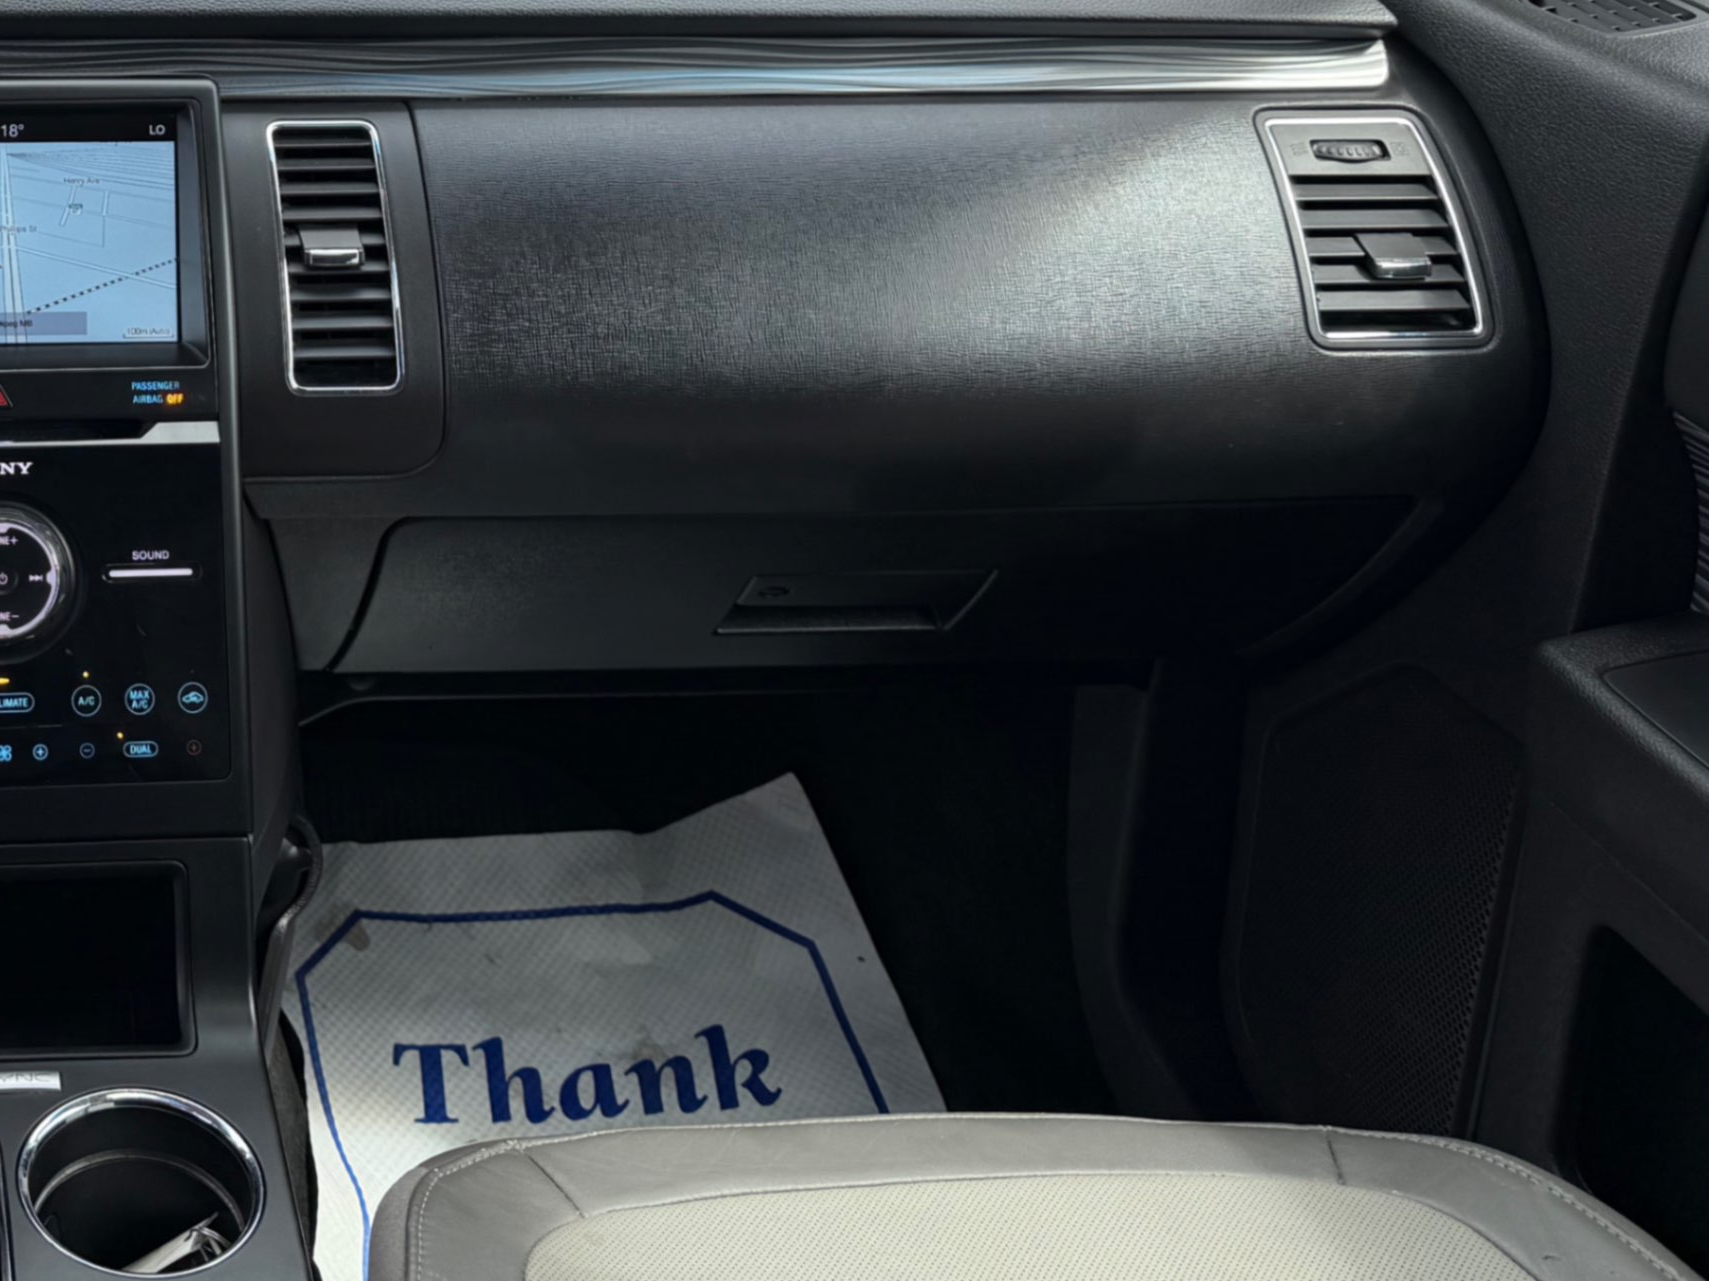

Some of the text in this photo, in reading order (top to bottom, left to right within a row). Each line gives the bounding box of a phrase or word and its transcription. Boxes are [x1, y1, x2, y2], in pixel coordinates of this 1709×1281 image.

[1, 124, 25, 138] 18°
[149, 125, 166, 135] LO
[132, 381, 180, 391] PASSENGER
[133, 393, 184, 405] AIRBAG OFF
[132, 550, 170, 560] SOUND
[78, 695, 95, 706] A/C
[130, 691, 150, 700] MAX
[131, 699, 149, 709] A/C
[129, 745, 152, 755] DUAL
[392, 1024, 782, 1124] Thank
